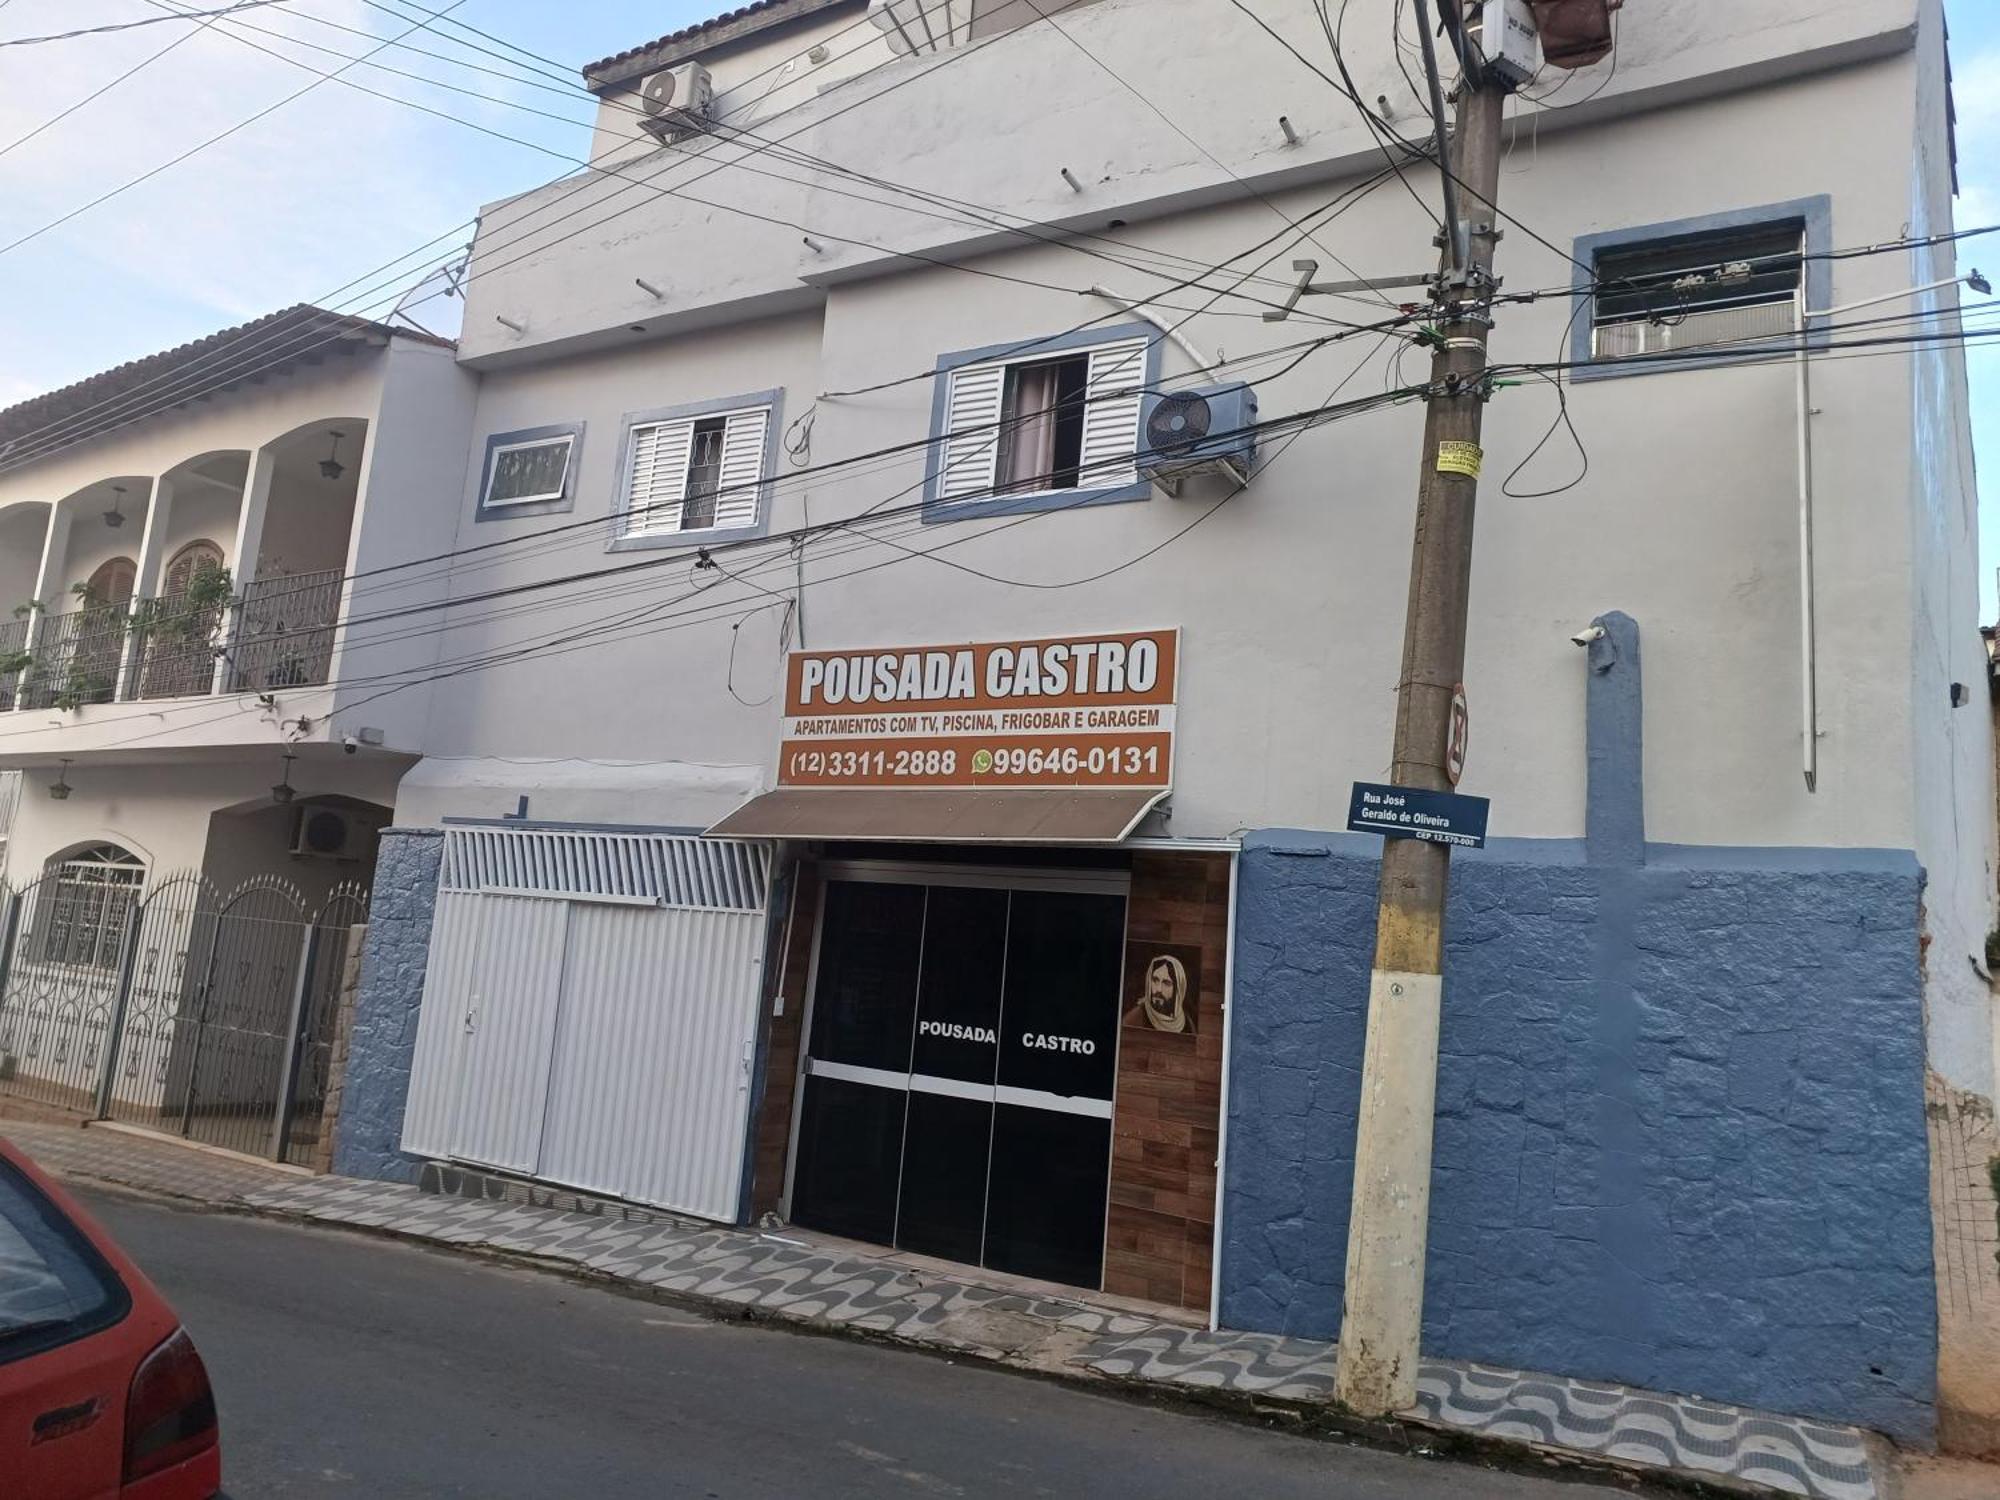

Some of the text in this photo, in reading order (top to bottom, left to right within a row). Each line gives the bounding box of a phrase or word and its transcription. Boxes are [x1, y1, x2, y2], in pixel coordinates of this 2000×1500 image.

[800, 638, 1160, 705] POUSADA CASTRO
[794, 709, 1159, 735] APARTAMENTOS COM TV, PISCINA, FRIGOBAR E GARAGEM
[994, 746, 1158, 774] 99646-0131
[1363, 792, 1405, 806] Rua José
[1361, 807, 1450, 827] Geraldo de Oliveira
[1415, 831, 1432, 840] CEP
[919, 1020, 1096, 1056] POUSADA CASTRO
